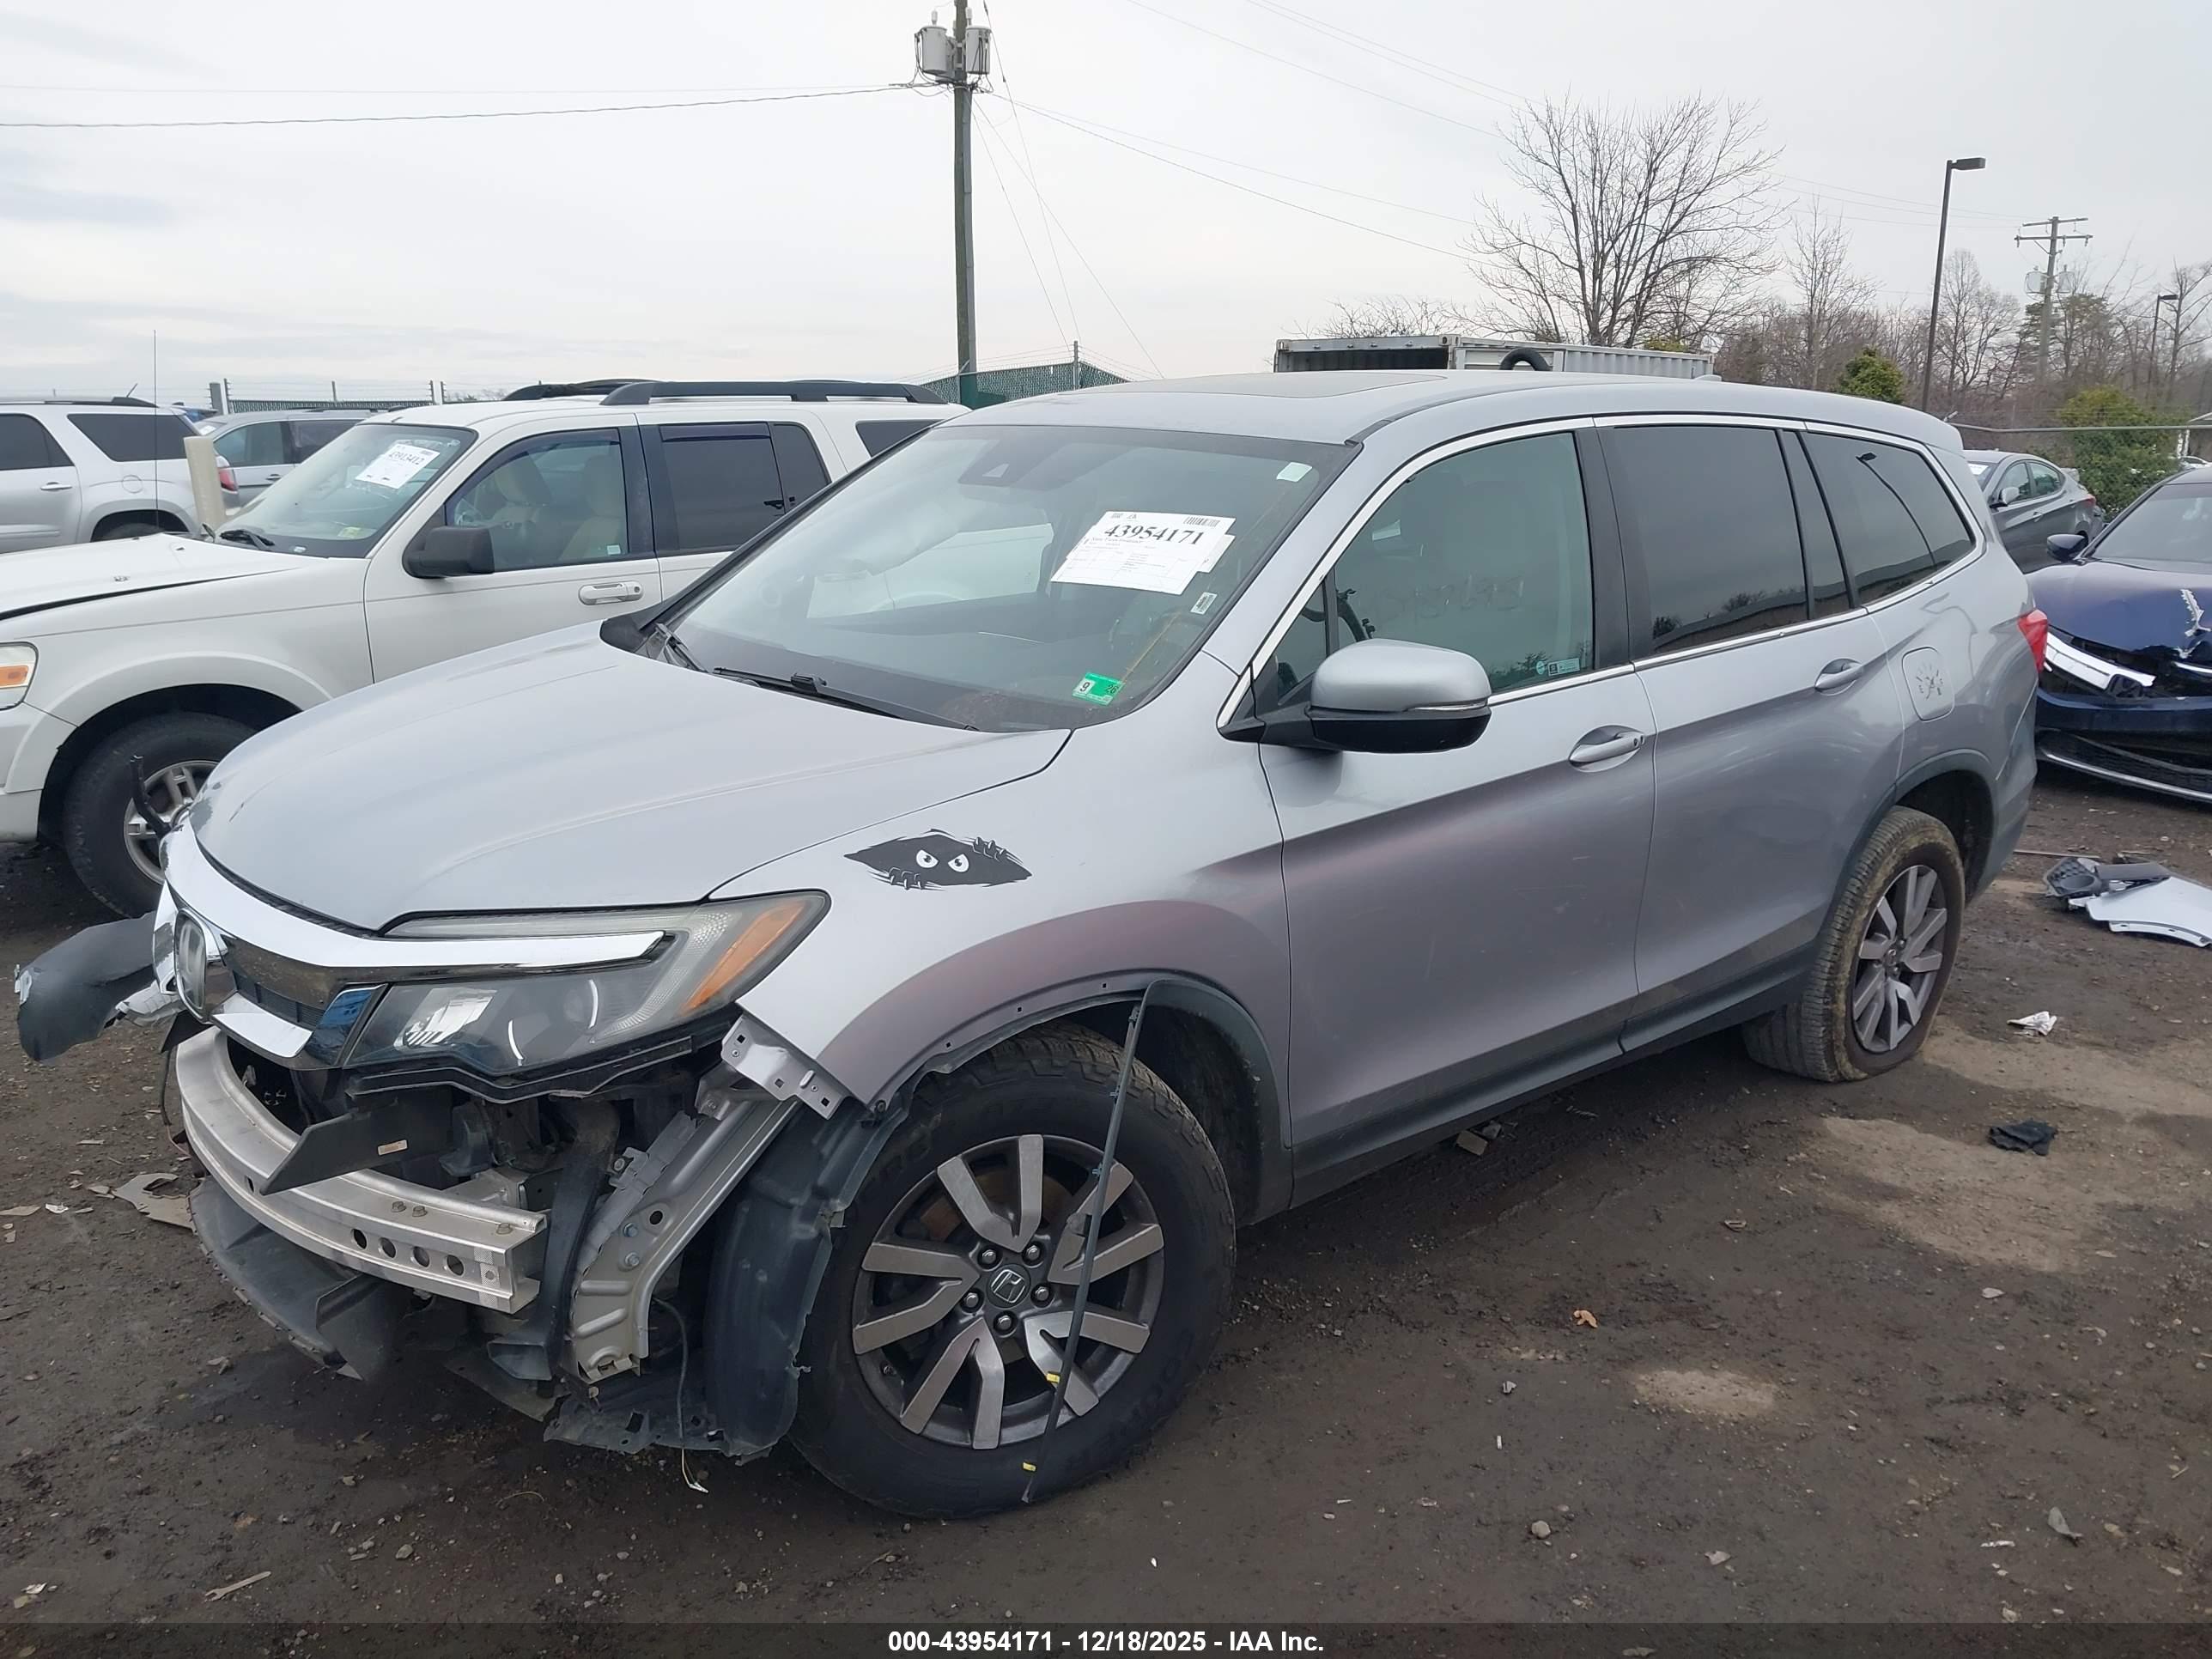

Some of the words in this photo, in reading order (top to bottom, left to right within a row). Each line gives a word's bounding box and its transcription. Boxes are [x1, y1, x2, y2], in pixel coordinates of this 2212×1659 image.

[1104, 524, 1204, 544] 43954171
[1079, 682, 1091, 692] 9
[1106, 684, 1119, 694] 26
